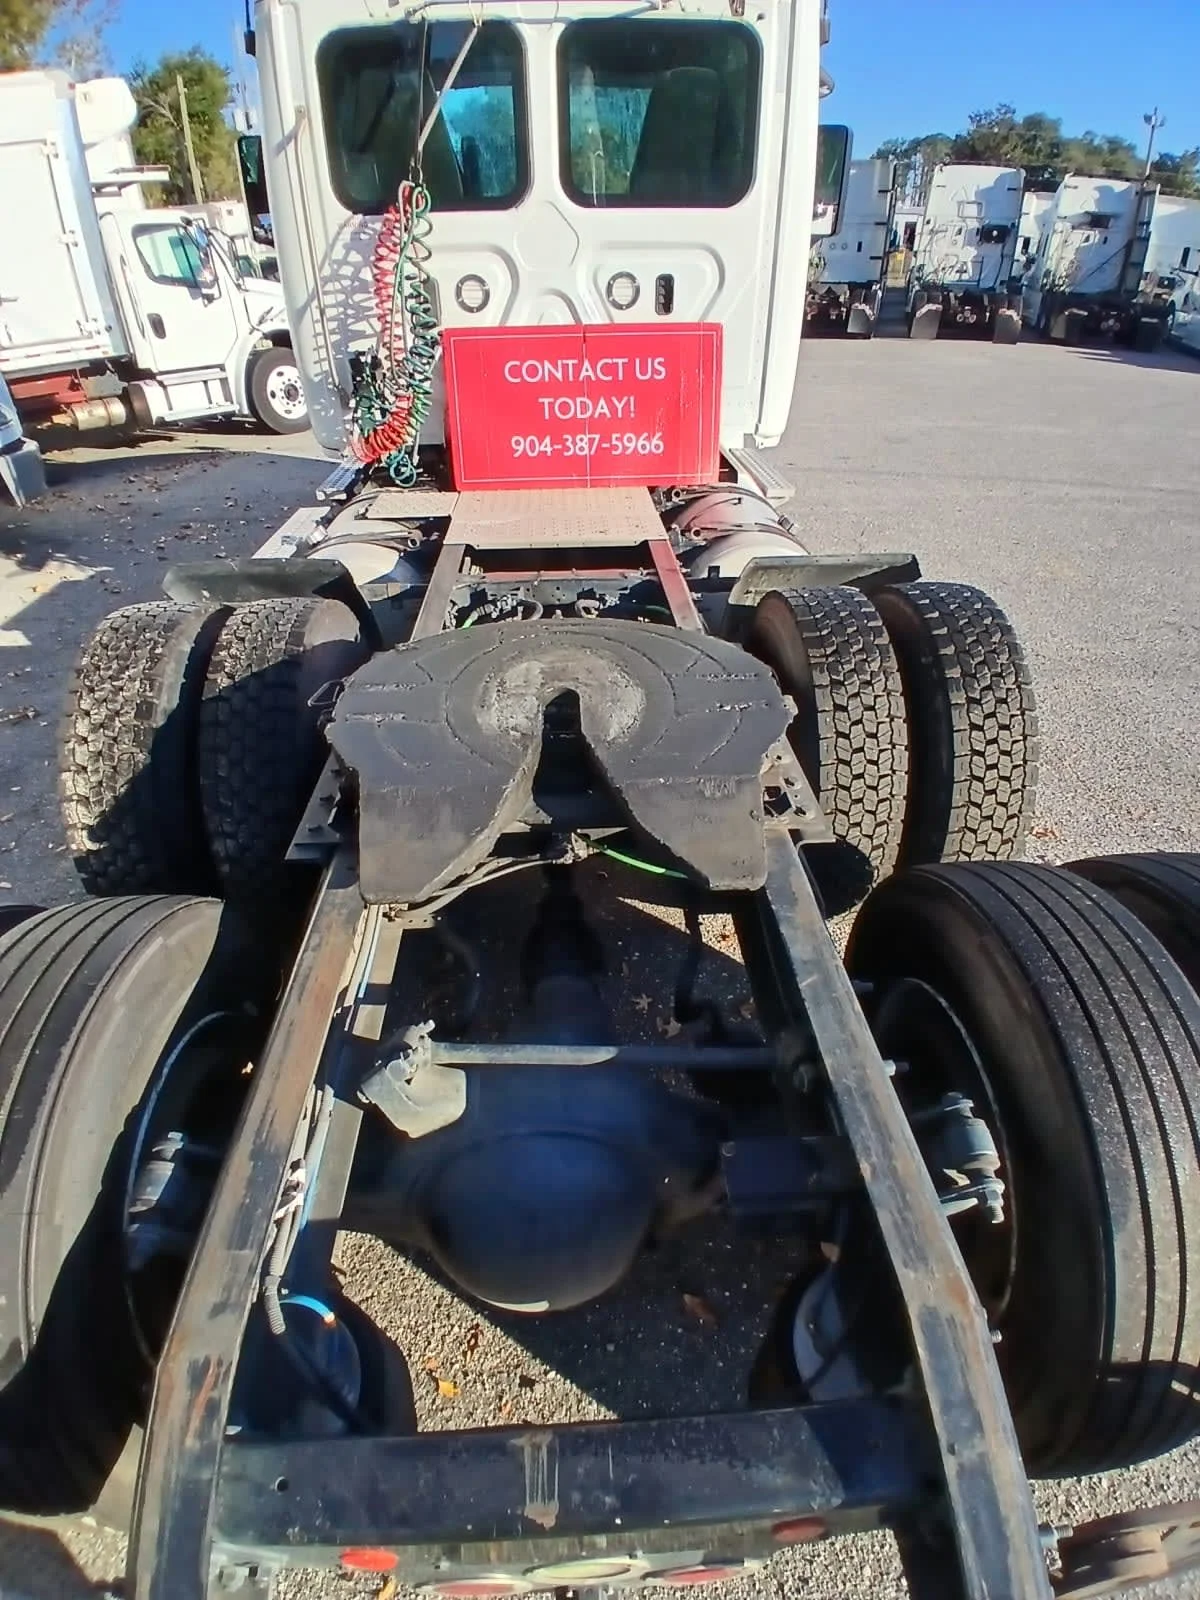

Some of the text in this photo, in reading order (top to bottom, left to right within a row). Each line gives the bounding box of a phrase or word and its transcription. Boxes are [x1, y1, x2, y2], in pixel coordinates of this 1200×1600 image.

[504, 357, 666, 383] CONTACT US
[538, 396, 636, 420] TODAY!
[511, 432, 664, 458] 904-387-5966
